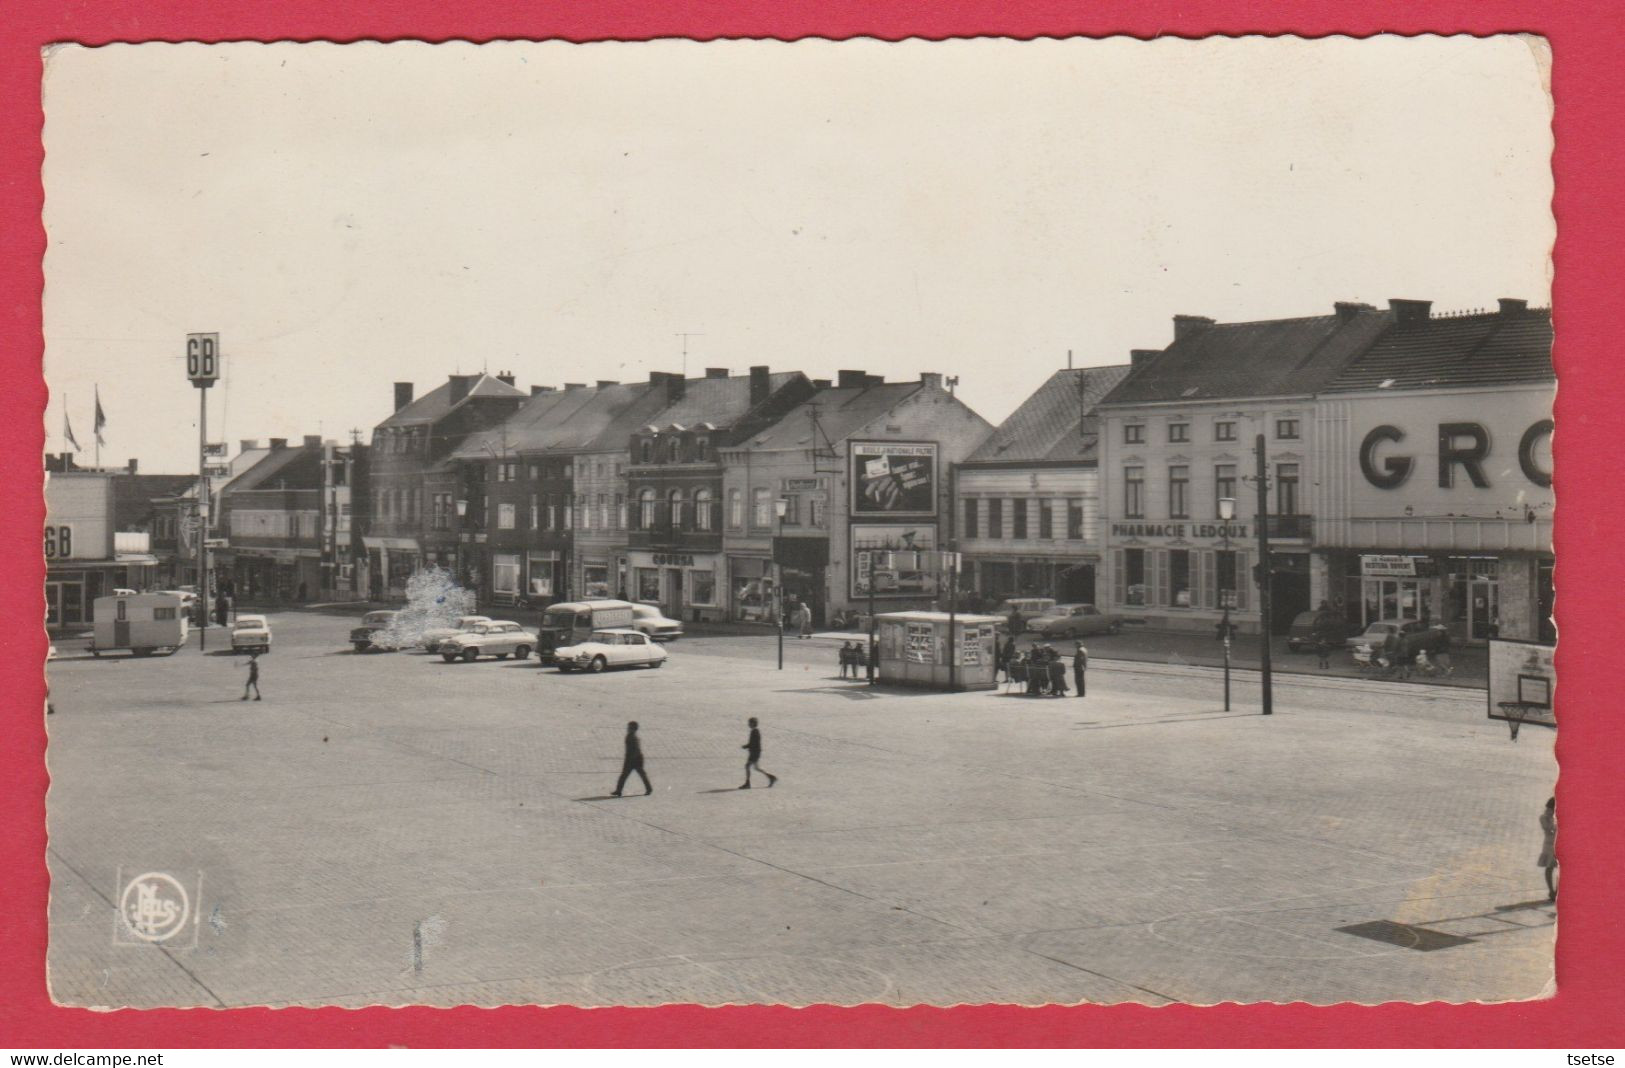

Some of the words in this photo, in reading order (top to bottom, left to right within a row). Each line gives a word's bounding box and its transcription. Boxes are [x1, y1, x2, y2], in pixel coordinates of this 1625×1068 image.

[187, 338, 215, 376] GB
[45, 526, 71, 558] GB
[1112, 524, 1185, 537] PHARMACIE
[1191, 525, 1248, 538] LEDOUX
